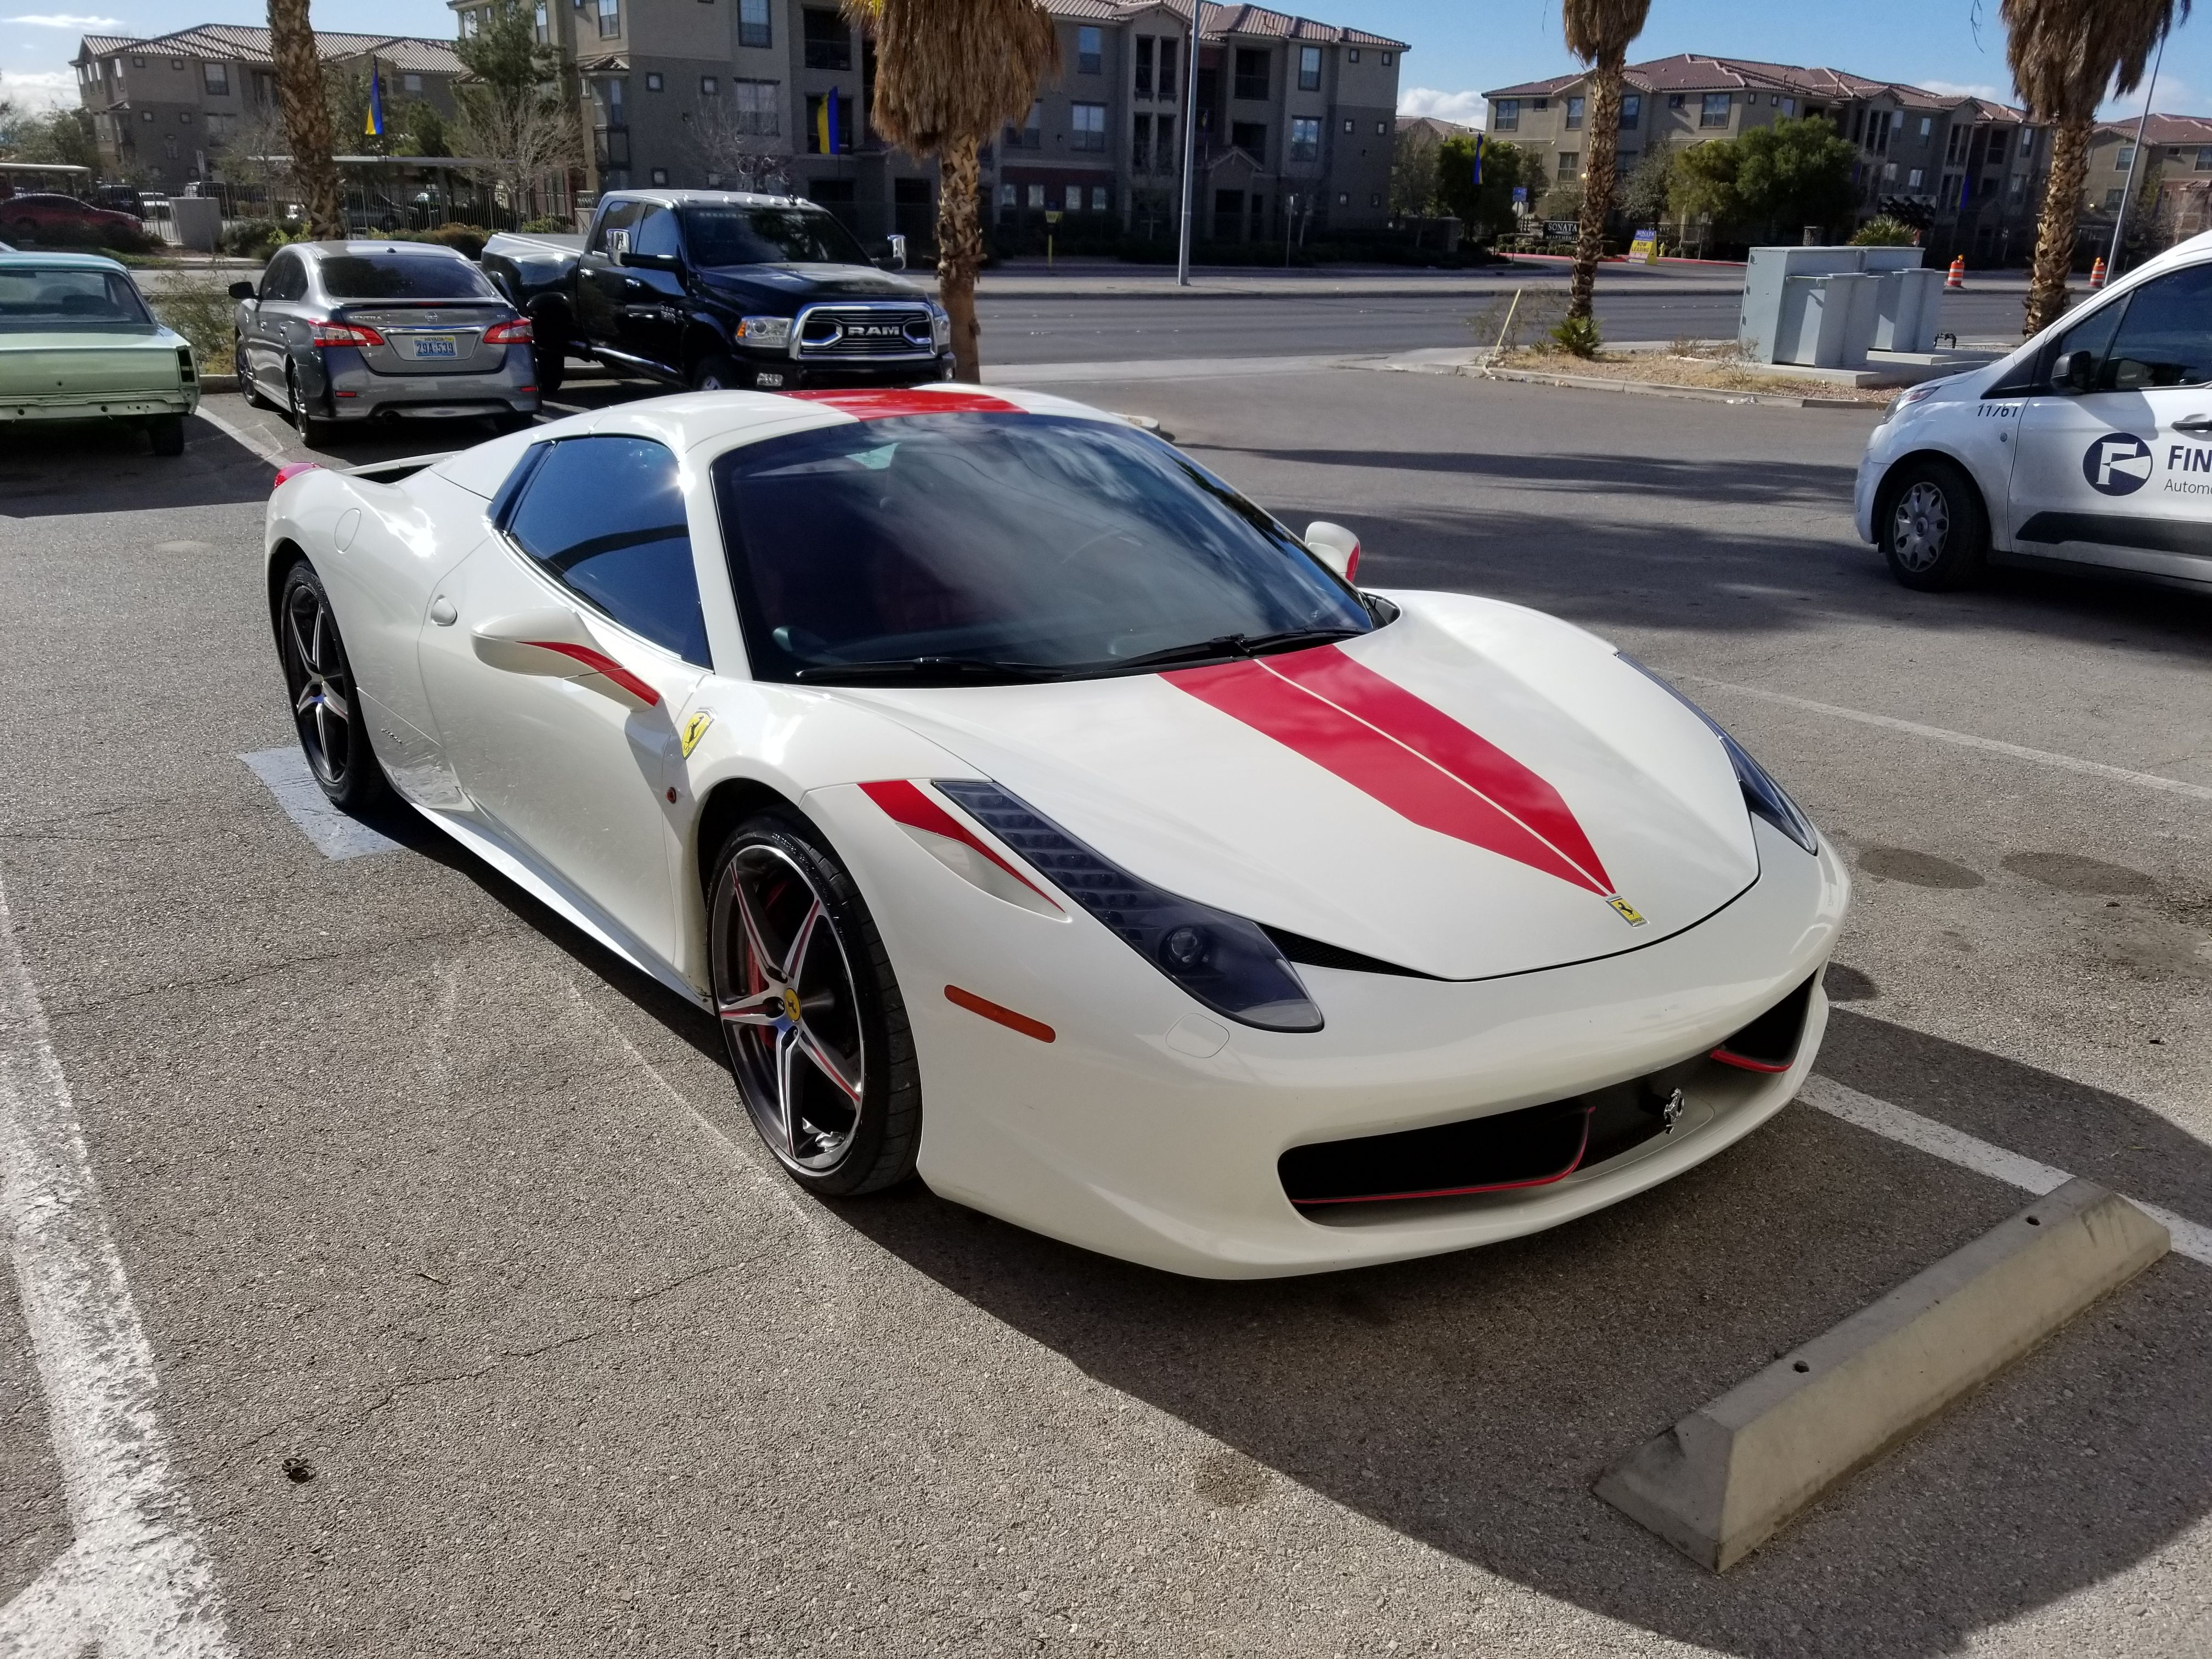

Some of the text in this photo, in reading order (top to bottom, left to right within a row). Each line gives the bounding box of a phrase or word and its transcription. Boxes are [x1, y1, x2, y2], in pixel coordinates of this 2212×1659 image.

[1548, 223, 1577, 232] SONATA
[848, 326, 900, 336] RAM
[1977, 403, 2019, 417] 11761
[2167, 445, 2212, 473] FIN
[2164, 478, 2212, 495] Autom
